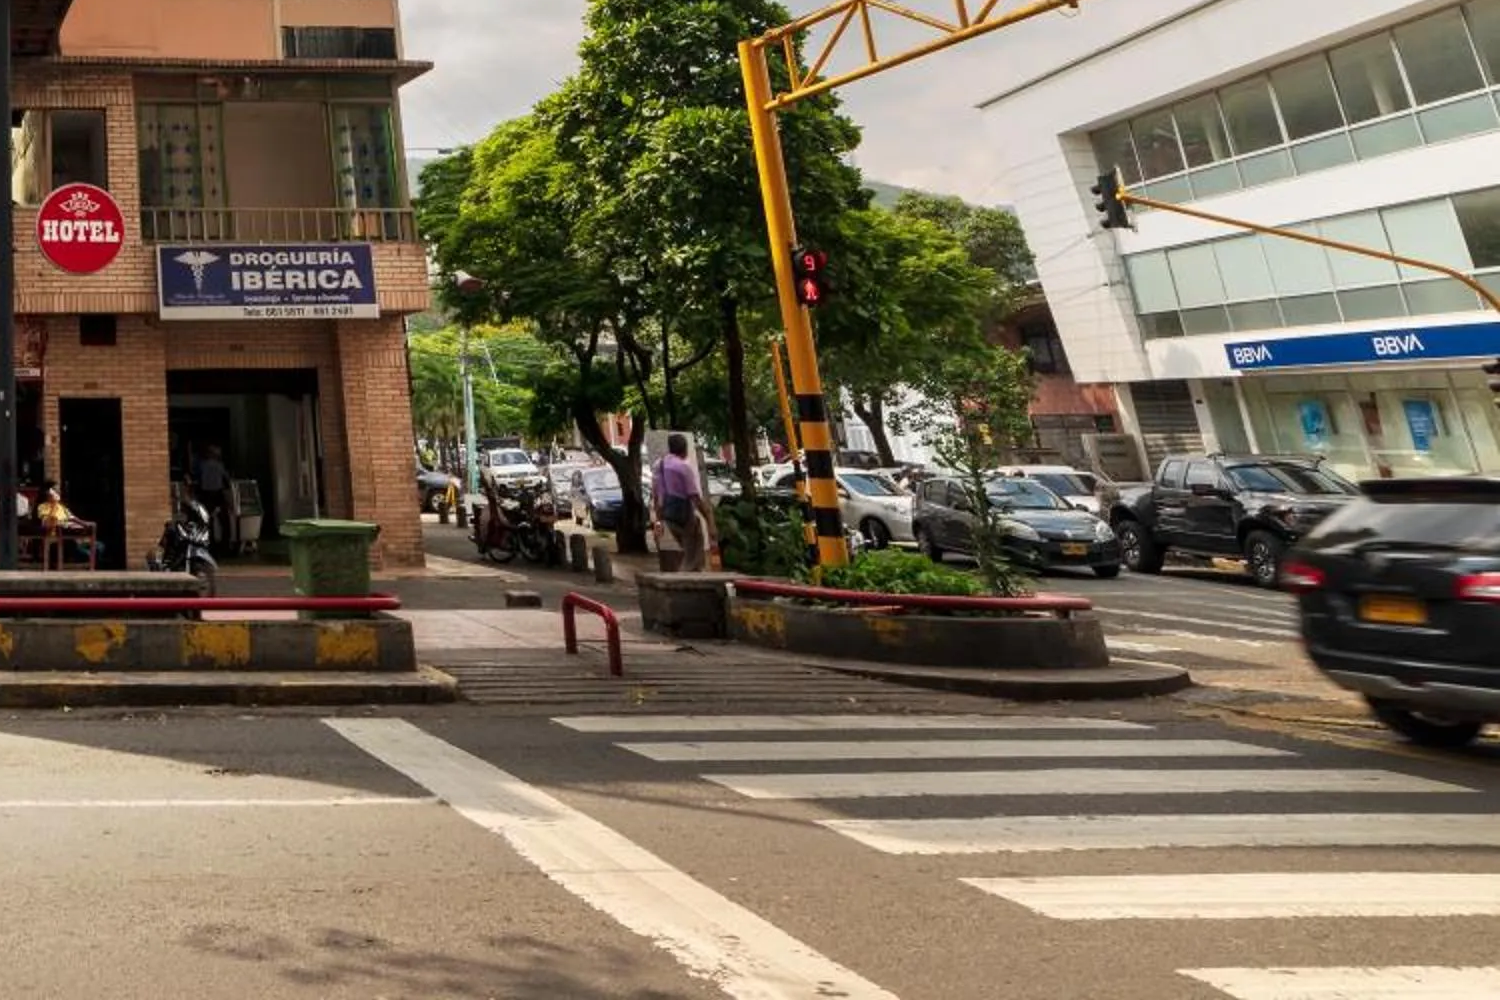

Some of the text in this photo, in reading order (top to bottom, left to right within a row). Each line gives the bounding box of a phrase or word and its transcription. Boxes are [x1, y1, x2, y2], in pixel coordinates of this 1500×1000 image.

[41, 219, 120, 243] HOTEL
[229, 248, 355, 266] DROGUERÍA
[231, 264, 364, 291] IBÉRICA
[1233, 344, 1273, 365] BBVA
[1372, 333, 1425, 356] BBVA
